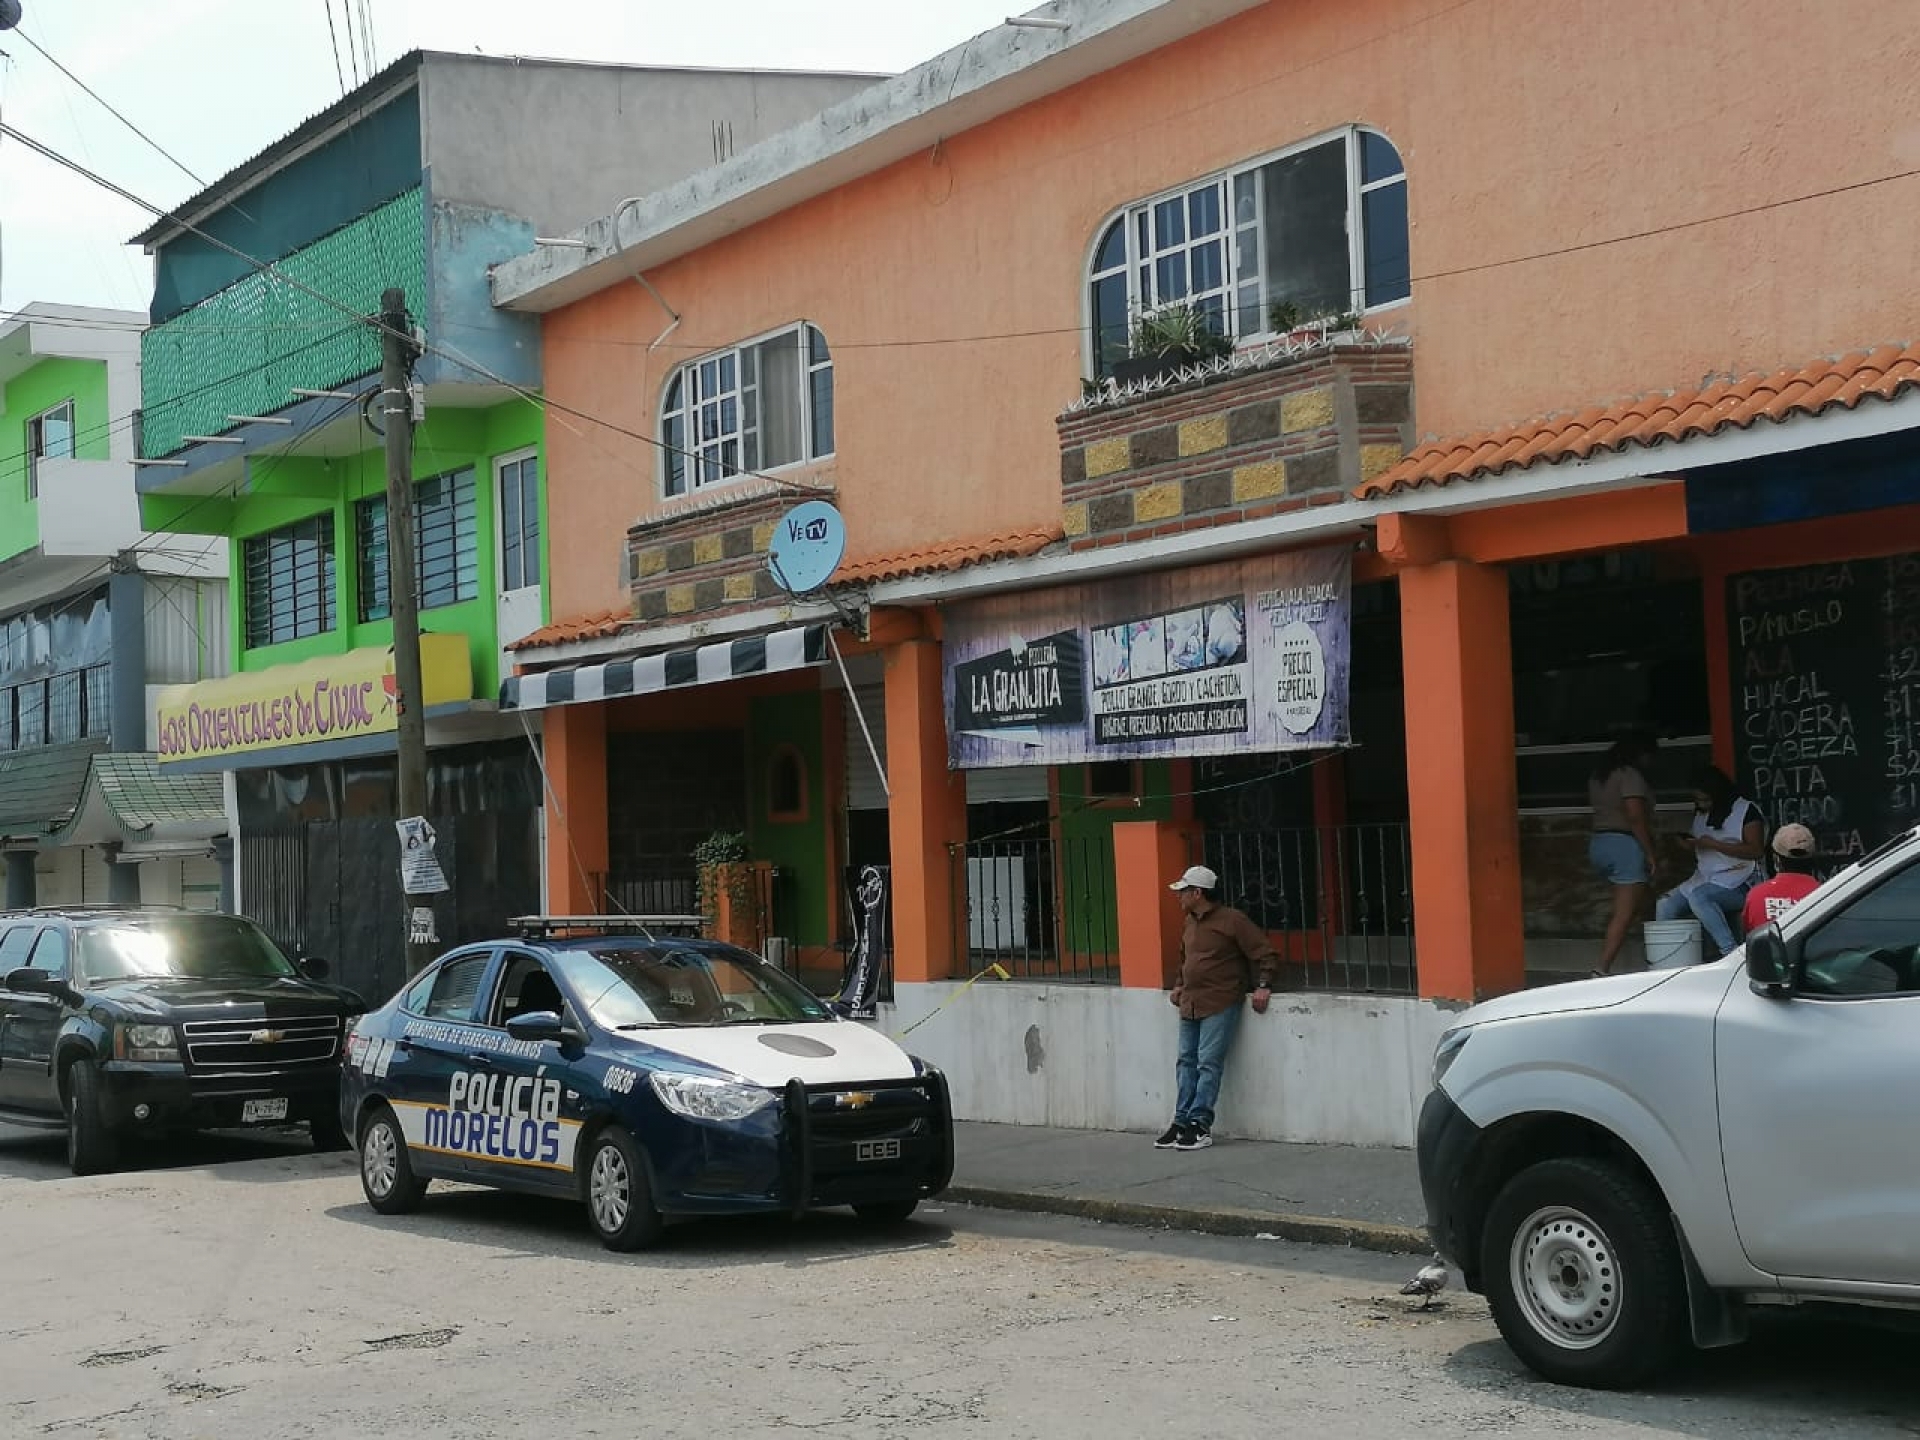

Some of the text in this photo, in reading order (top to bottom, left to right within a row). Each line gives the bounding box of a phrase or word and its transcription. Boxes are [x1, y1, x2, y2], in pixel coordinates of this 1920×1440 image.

[1283, 651, 1311, 675] PRECIO
[972, 666, 1062, 713] LA GRANJITA
[1189, 681, 1195, 701] Y
[1278, 677, 1317, 702] ESPECIAL
[158, 710, 186, 755] LOS
[189, 696, 292, 752] ORIENTALES
[314, 678, 373, 735] CIVAC
[1746, 702, 1855, 737] CADERA
[1749, 735, 1858, 765] CABEZA
[1755, 765, 1828, 798] PATA
[461, 1031, 501, 1050] DERECHOS
[501, 1038, 544, 1059] HUMANOS
[426, 1109, 561, 1163] MORELOS
